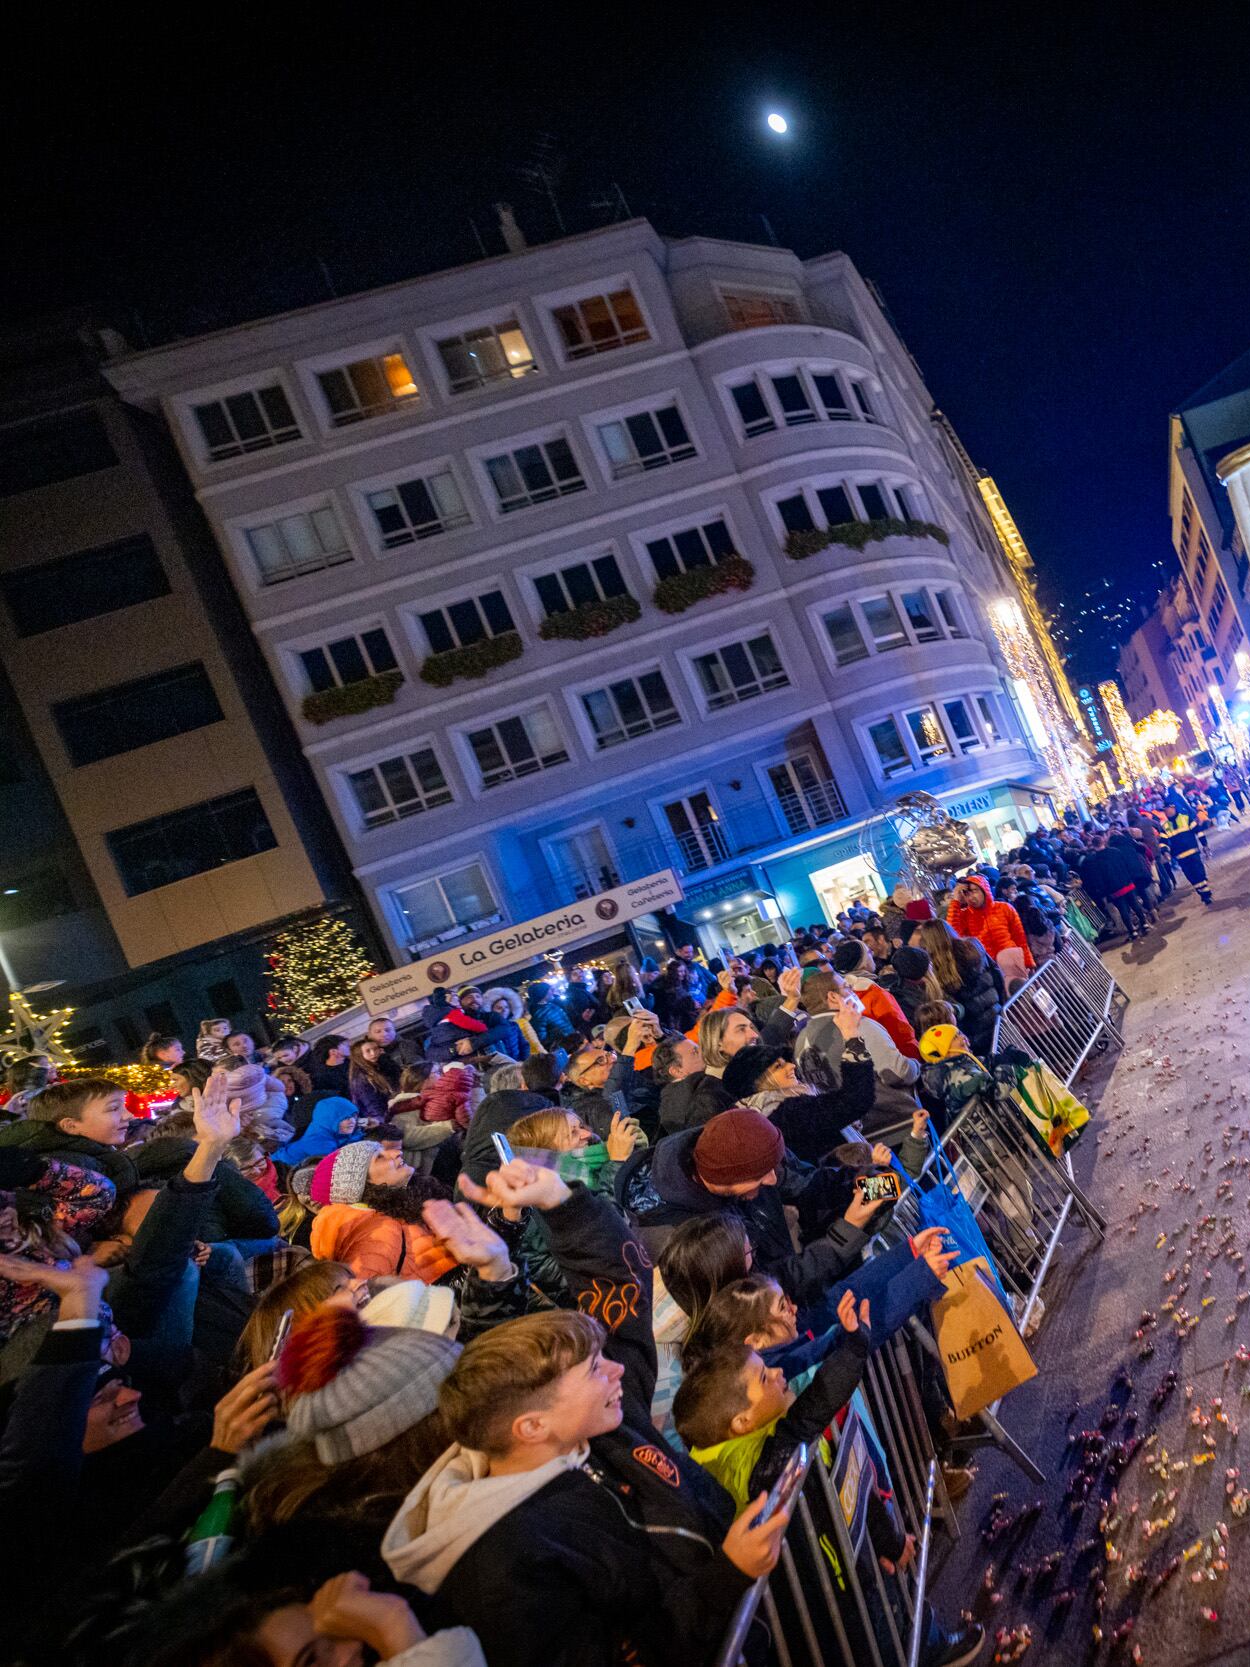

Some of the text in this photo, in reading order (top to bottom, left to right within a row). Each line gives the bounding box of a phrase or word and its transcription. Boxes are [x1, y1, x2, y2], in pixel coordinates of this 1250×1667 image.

[947, 794, 991, 818] ORTENY
[627, 877, 669, 896] Gelateria
[459, 950, 487, 966] La
[488, 914, 585, 955] Gelateria
[369, 974, 413, 993] Gelateria
[947, 1324, 1003, 1365] BURTON
